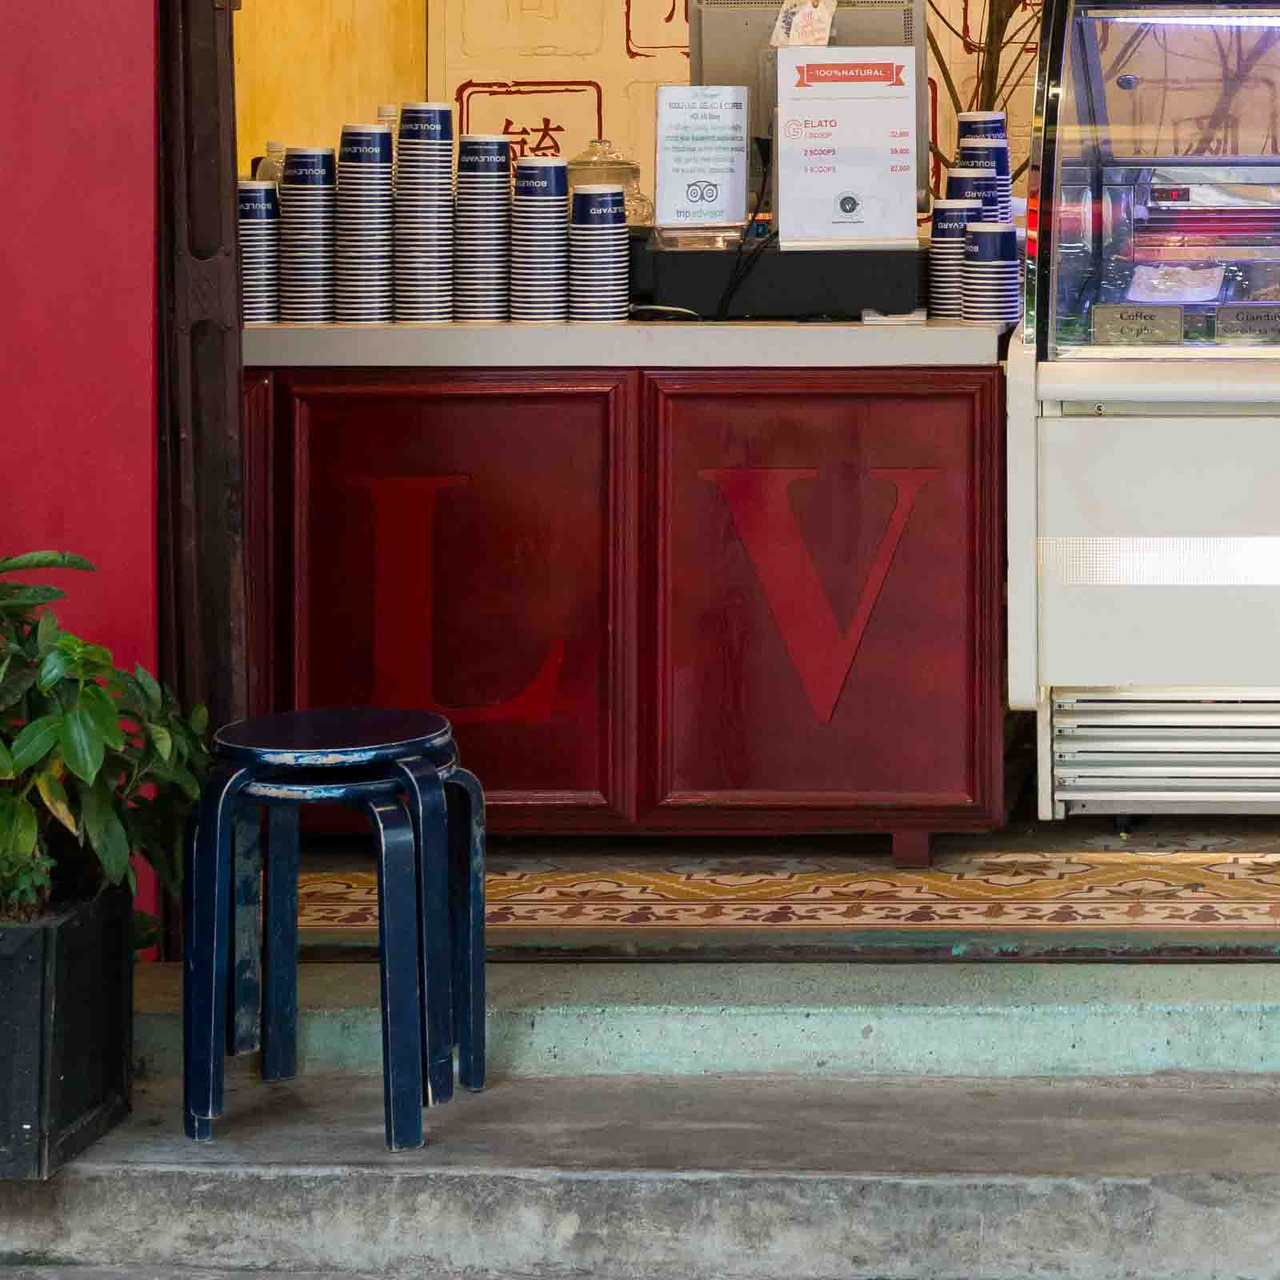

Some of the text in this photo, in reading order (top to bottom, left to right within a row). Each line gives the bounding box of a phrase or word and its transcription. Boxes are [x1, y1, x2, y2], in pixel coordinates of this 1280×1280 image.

[1120, 311, 1157, 321] Coffee
[343, 472, 565, 721] L
[700, 467, 940, 724] V
